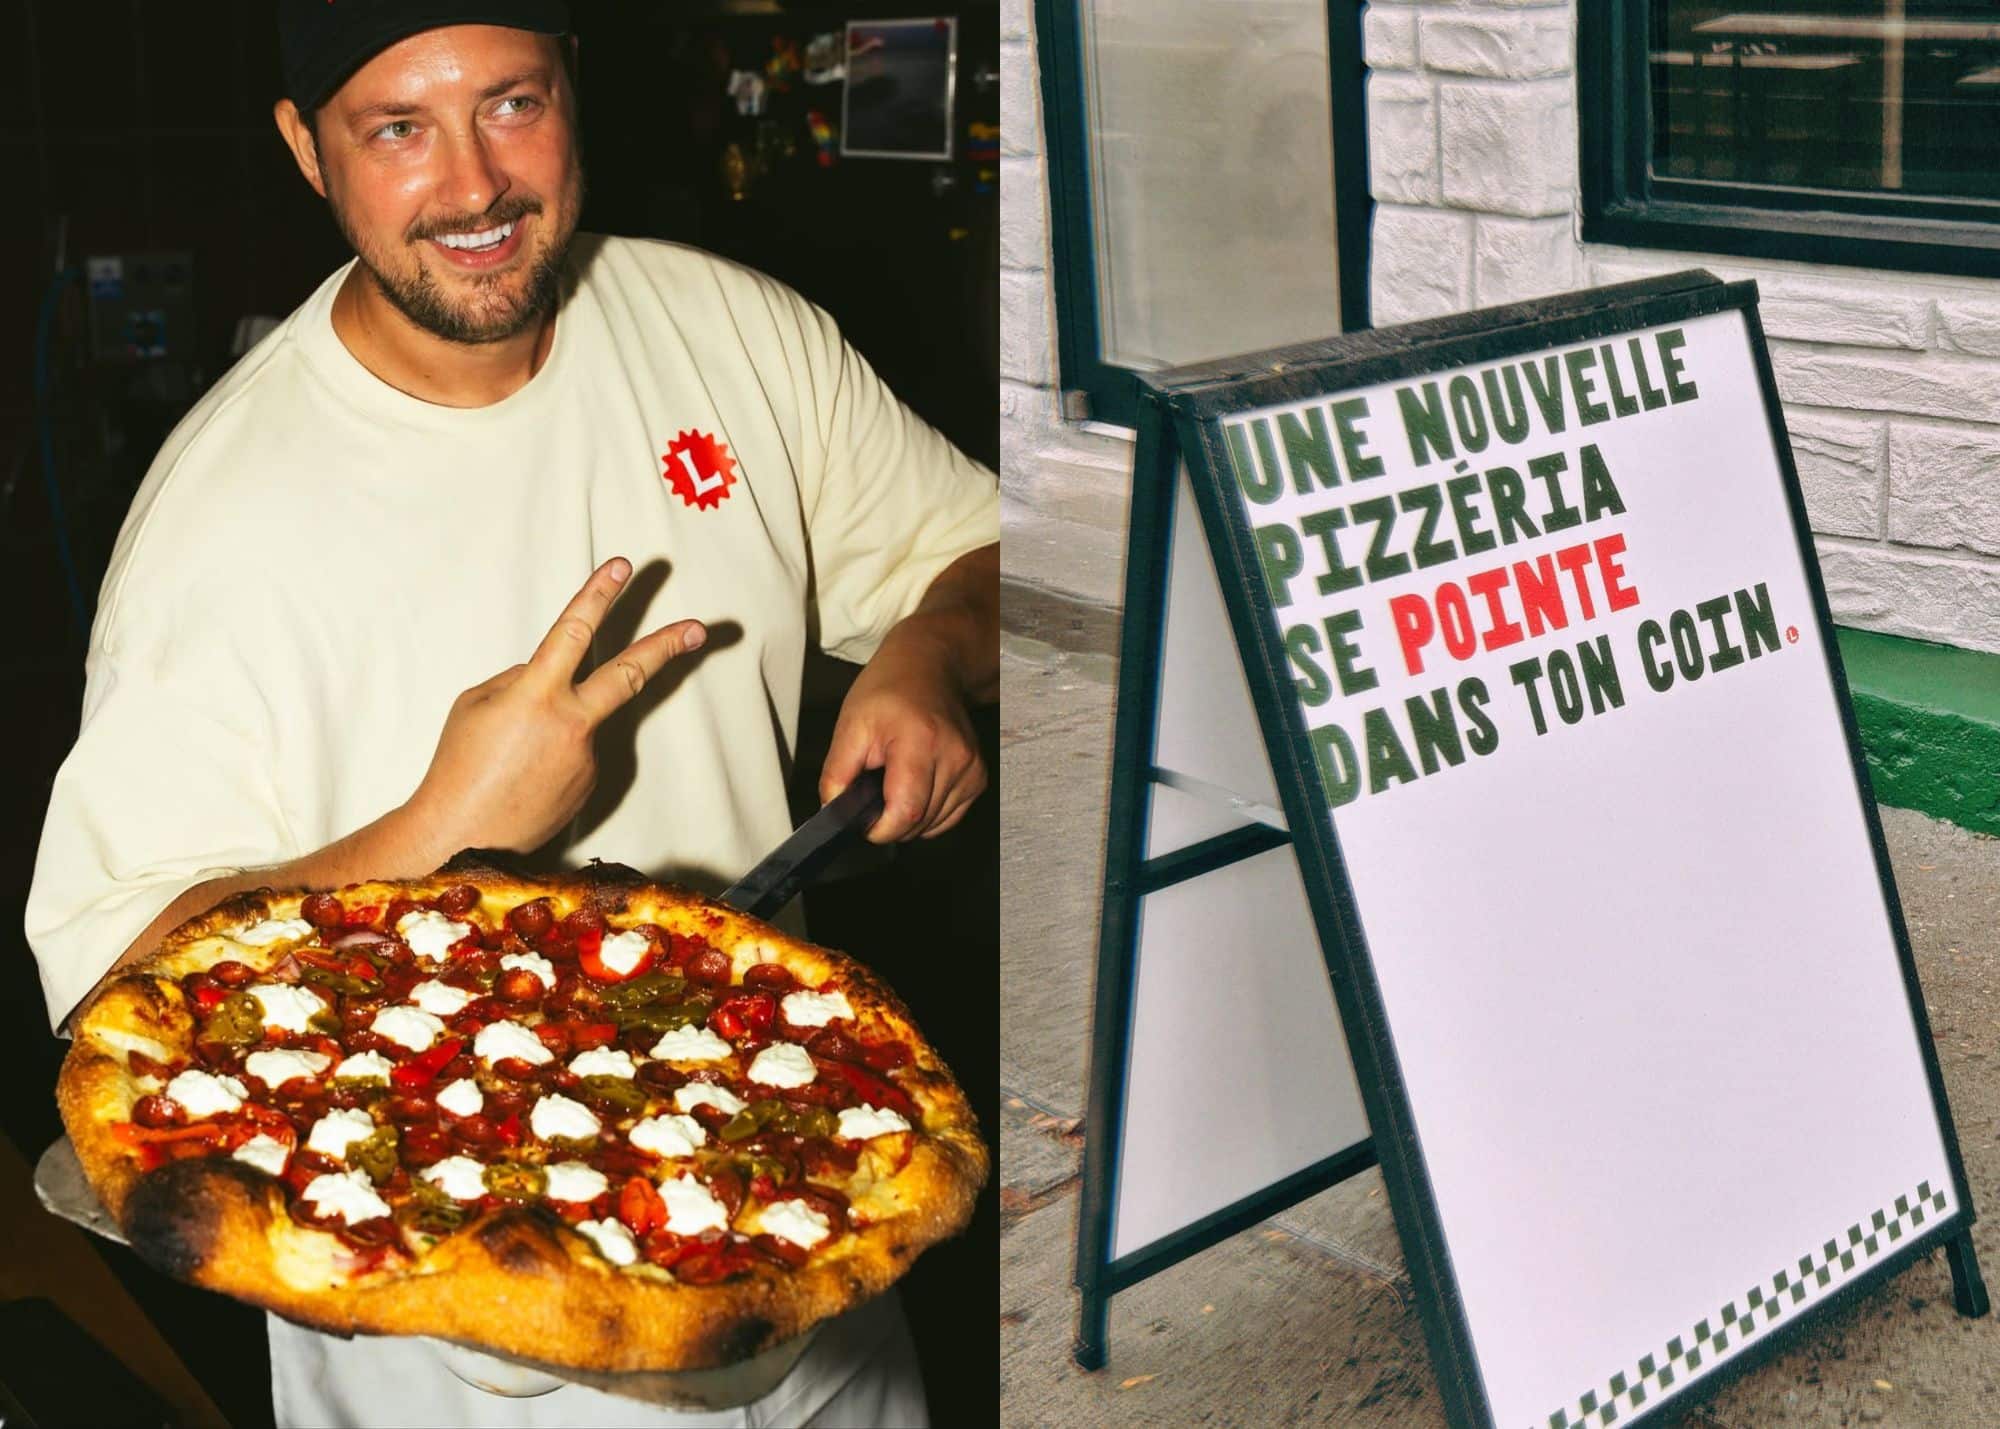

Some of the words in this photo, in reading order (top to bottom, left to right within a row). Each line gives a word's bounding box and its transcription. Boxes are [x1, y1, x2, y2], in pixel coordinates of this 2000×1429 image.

[676, 448, 724, 497] L
[1224, 397, 1386, 505] UNE
[1395, 328, 1699, 468] NOUVELLE
[1252, 444, 1627, 608] PIZZÉRIA
[1283, 609, 1381, 708] SE
[1389, 533, 1641, 677] POINTE
[1306, 677, 1499, 809] DANS
[1510, 634, 1626, 736] TON
